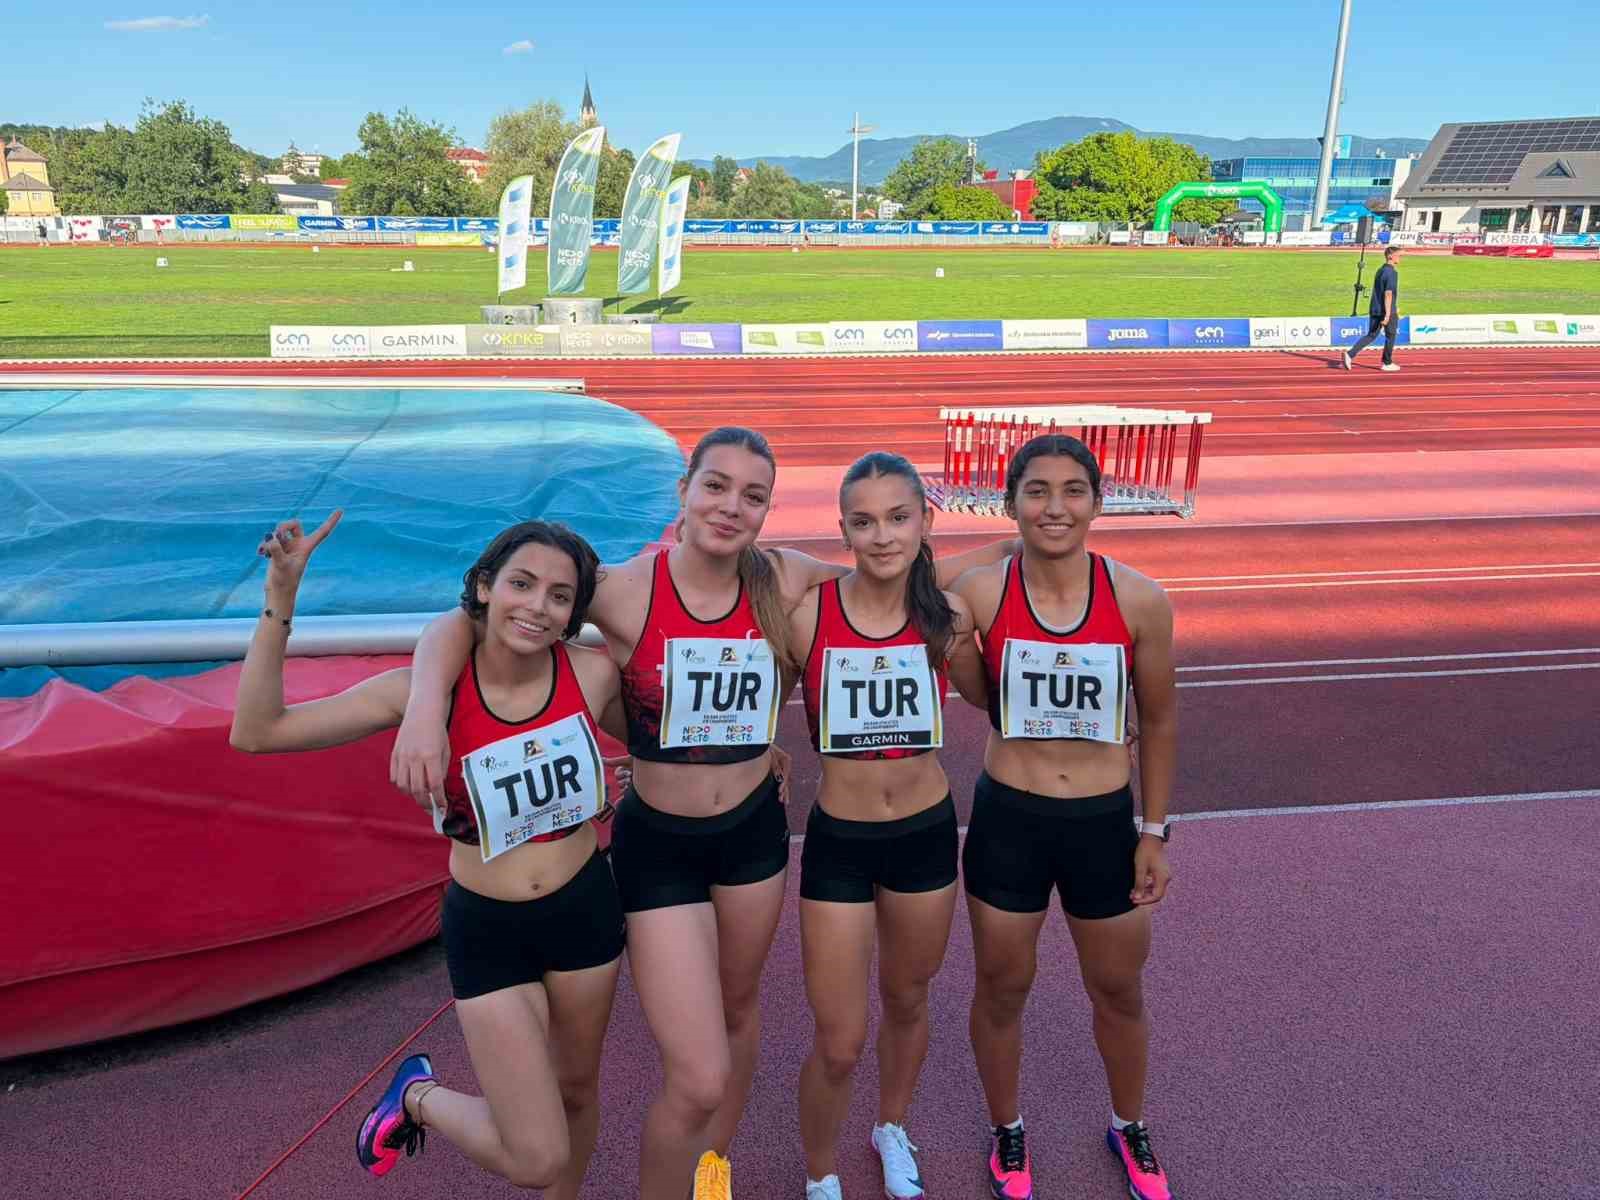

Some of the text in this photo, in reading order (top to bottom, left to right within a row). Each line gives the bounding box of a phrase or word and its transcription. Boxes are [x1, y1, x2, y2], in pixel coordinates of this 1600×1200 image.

[569, 311, 577, 323] 1
[382, 334, 457, 347] GARMIN
[687, 671, 762, 712] TUR
[841, 677, 920, 719] TUR
[1022, 671, 1102, 710] TUR
[851, 734, 911, 746] GARMIN
[493, 755, 582, 818] TUR
